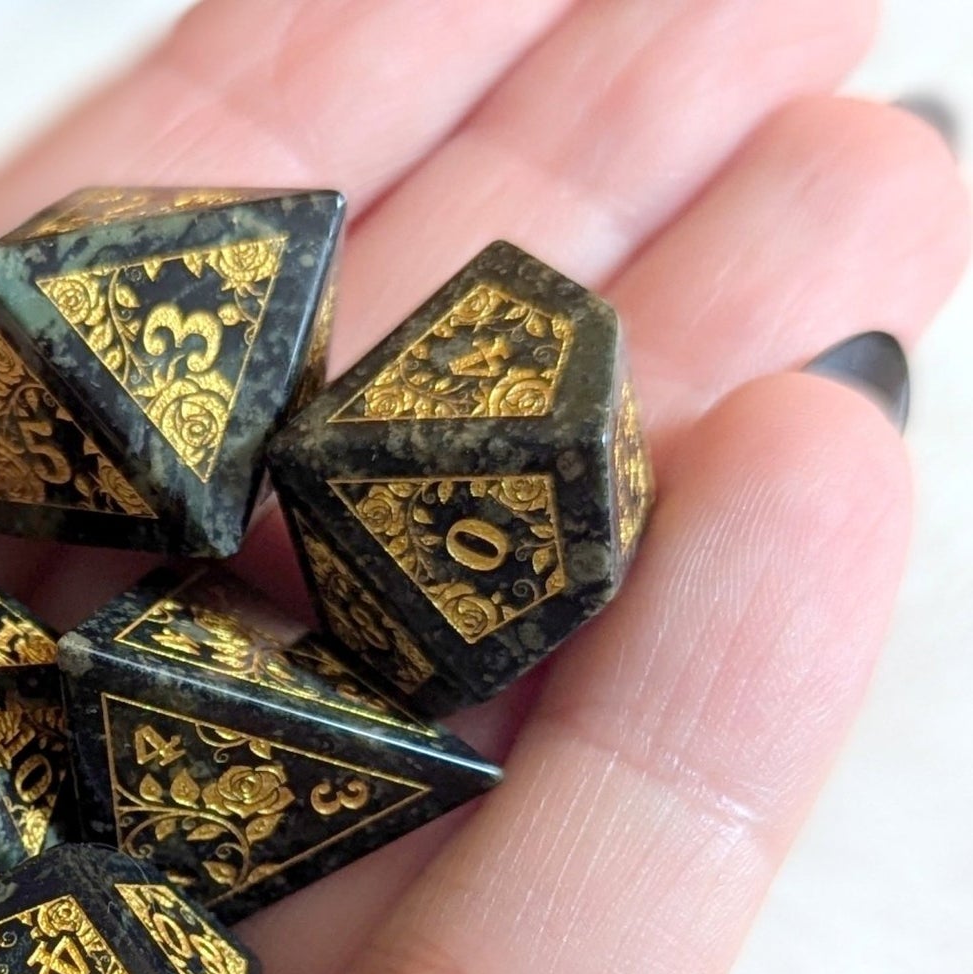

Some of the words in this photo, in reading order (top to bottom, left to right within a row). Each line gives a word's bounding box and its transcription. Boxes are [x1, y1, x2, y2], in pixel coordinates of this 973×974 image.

[143, 302, 222, 374] 3
[447, 337, 510, 378] 4
[19, 419, 72, 485] 5
[445, 518, 508, 572] 0
[133, 725, 187, 767] 4
[310, 778, 370, 816] 3
